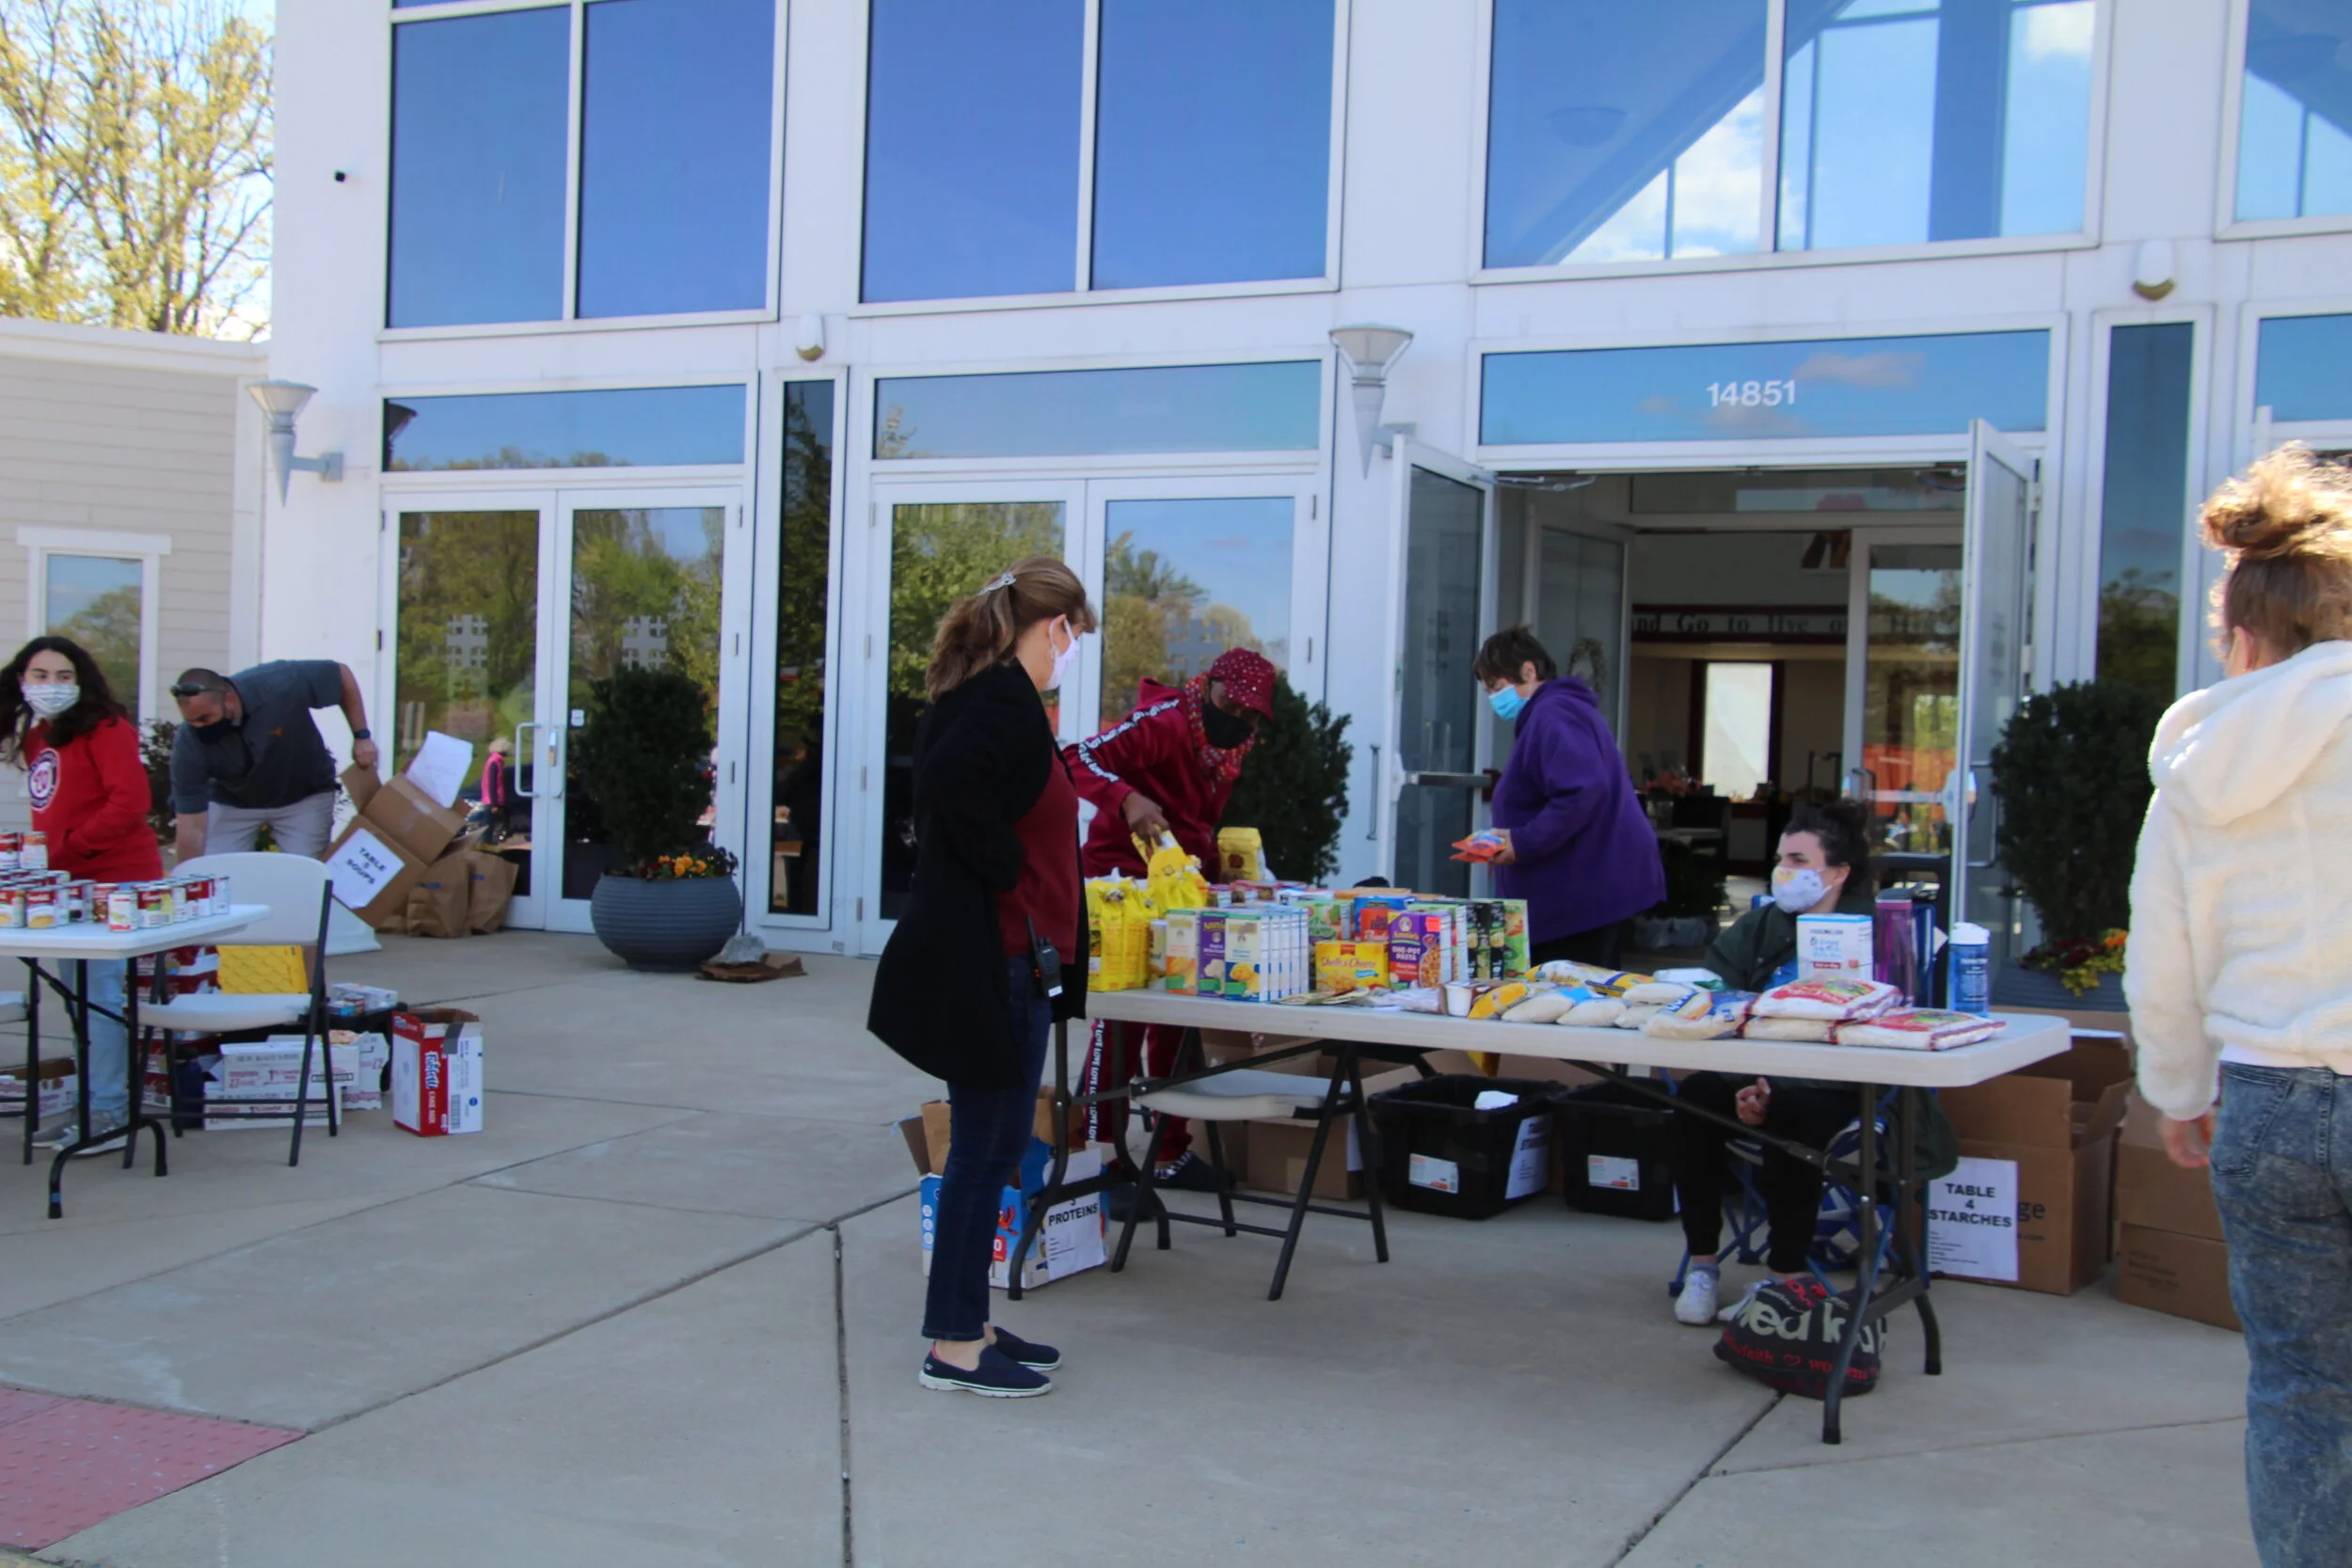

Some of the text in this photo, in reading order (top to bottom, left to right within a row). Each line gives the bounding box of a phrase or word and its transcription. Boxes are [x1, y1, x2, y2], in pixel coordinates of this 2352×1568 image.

[1705, 380, 1796, 407] 14851
[1677, 612, 1709, 633] Go
[1727, 615, 1750, 633] to
[1945, 1182, 1996, 1198] TABLE
[1964, 1198, 1975, 1210] 4
[1048, 1203, 1098, 1227] PROTEINS
[1929, 1209, 2012, 1227] STARCHES
